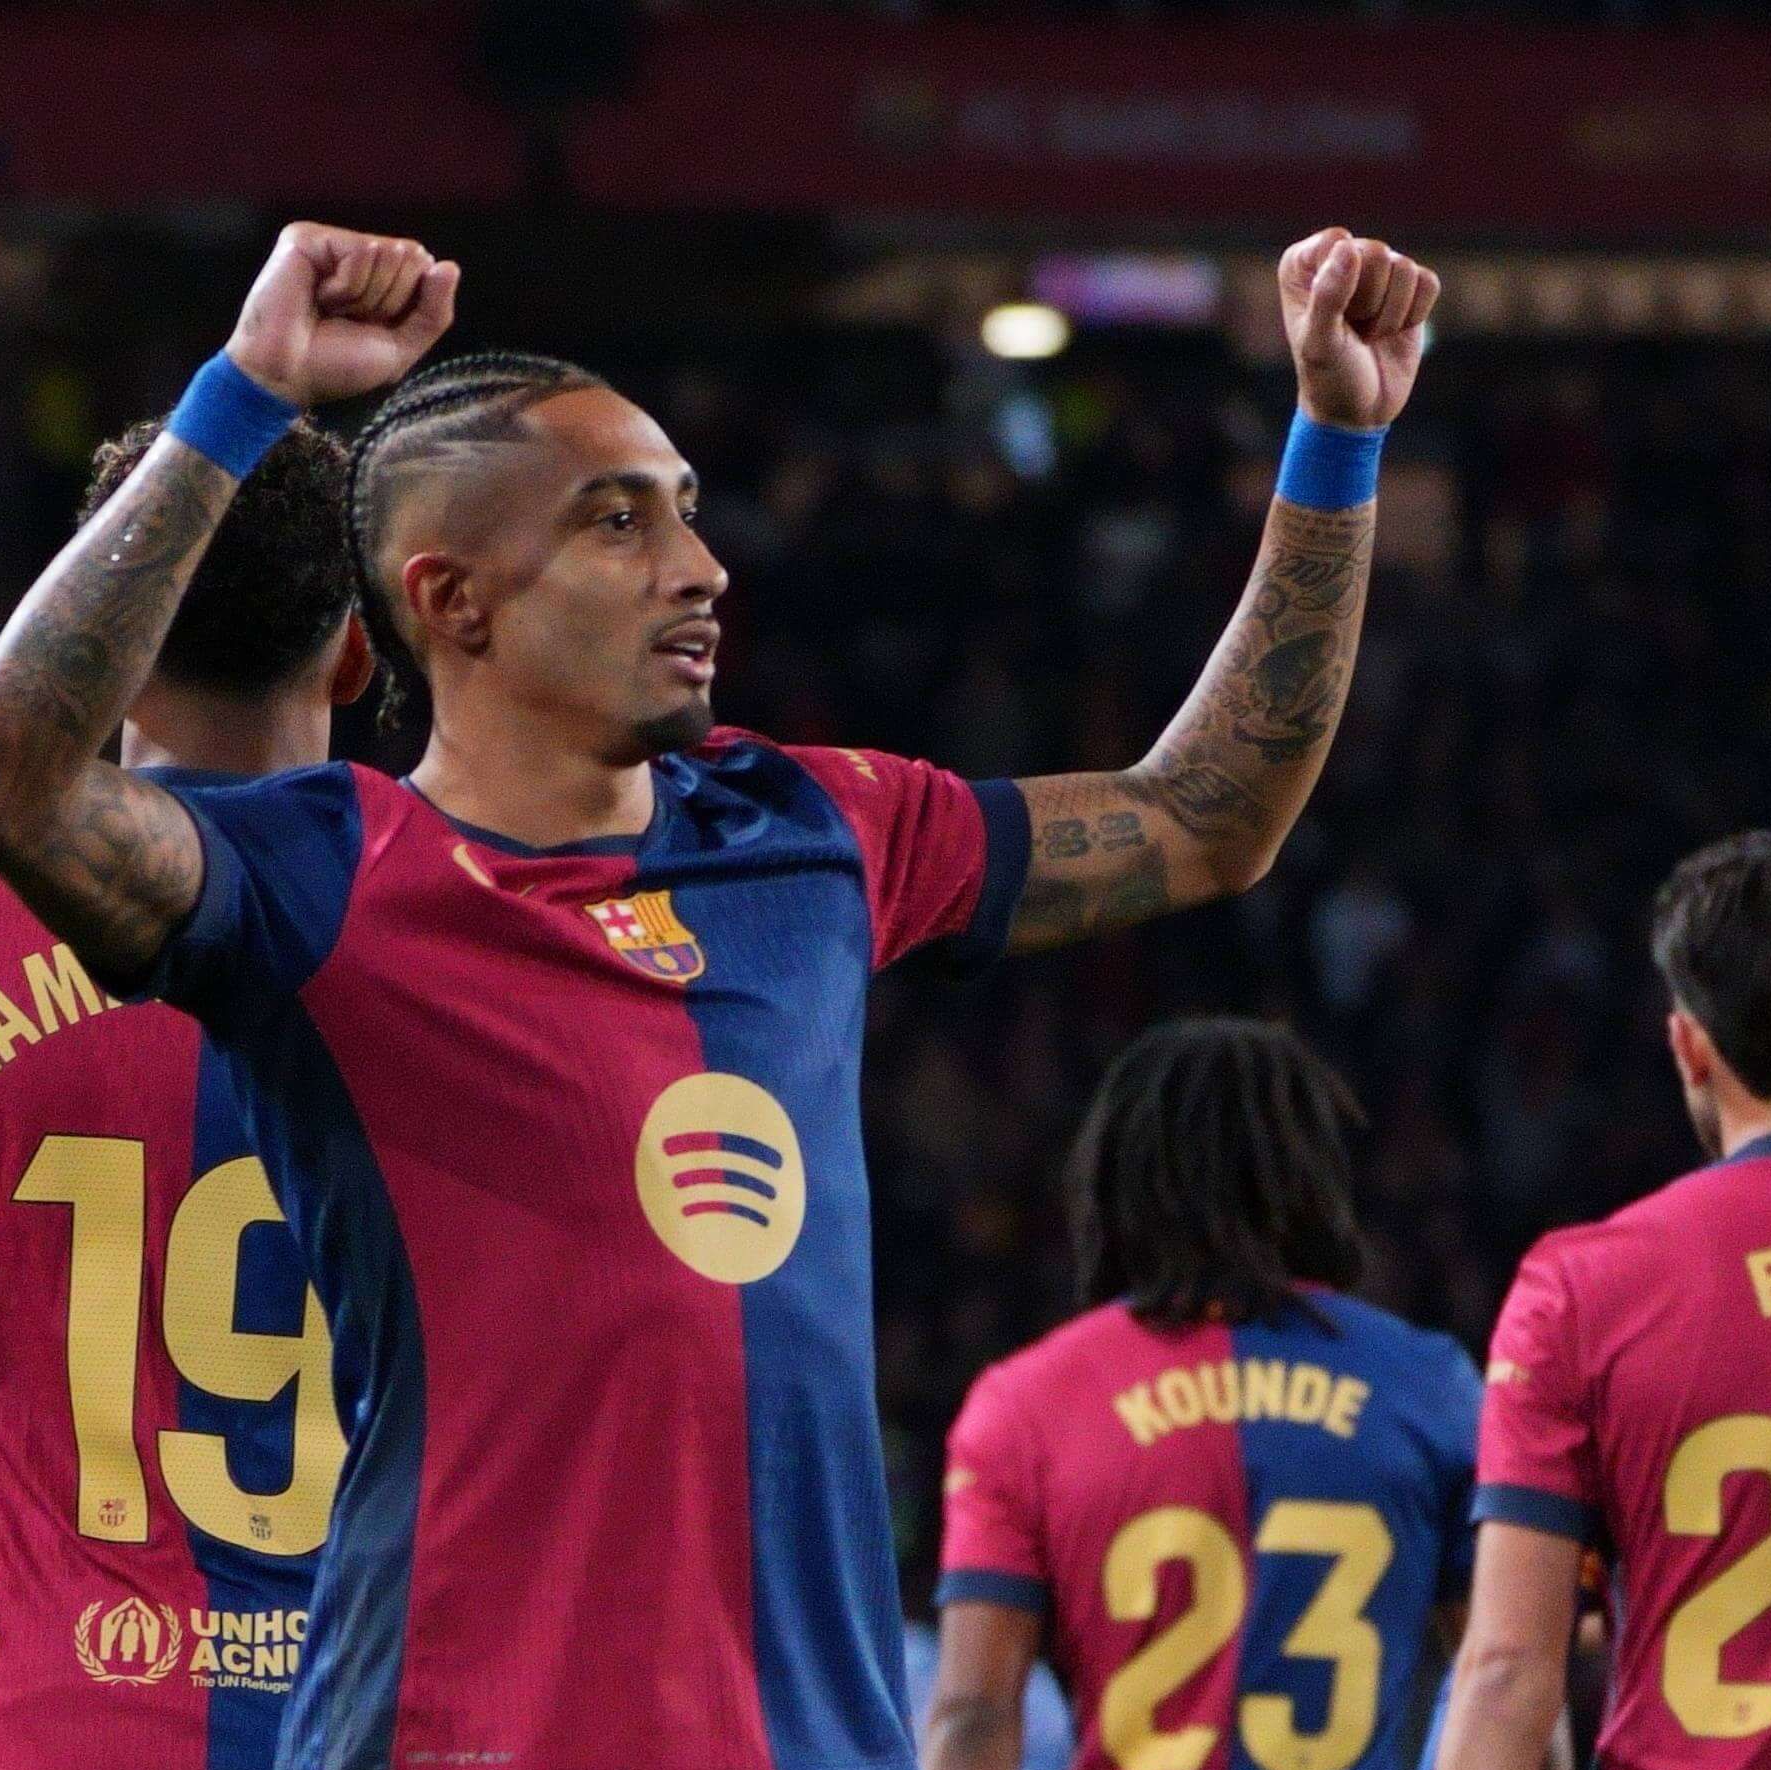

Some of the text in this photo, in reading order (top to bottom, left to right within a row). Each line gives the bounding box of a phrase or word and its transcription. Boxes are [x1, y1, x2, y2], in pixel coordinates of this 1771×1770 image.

[12, 1134, 351, 1557] 19
[1114, 1356, 1371, 1446] KOUNDE
[190, 1608, 309, 1643] UNHC
[189, 1638, 299, 1677] ACN
[190, 1675, 293, 1694] The UN Refuge
